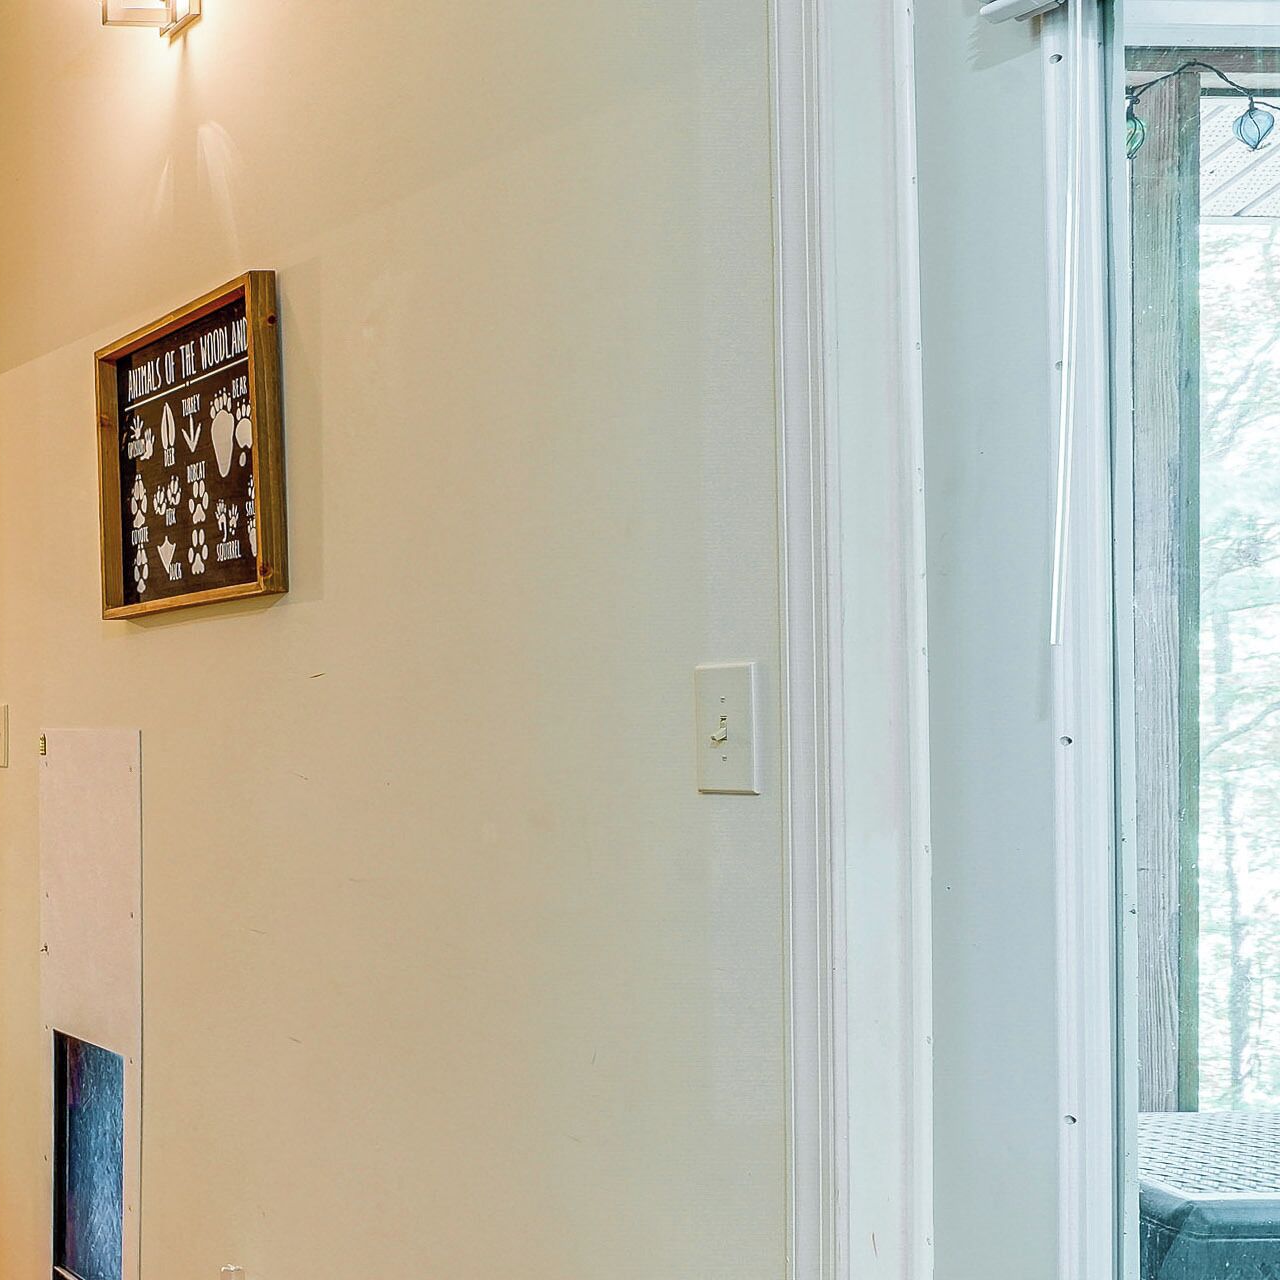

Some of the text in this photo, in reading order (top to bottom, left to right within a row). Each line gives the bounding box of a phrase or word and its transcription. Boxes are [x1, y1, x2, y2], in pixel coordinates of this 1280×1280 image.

[127, 316, 248, 402] ANIMALS OF THE WOODLAND
[231, 375, 248, 399] BEAR
